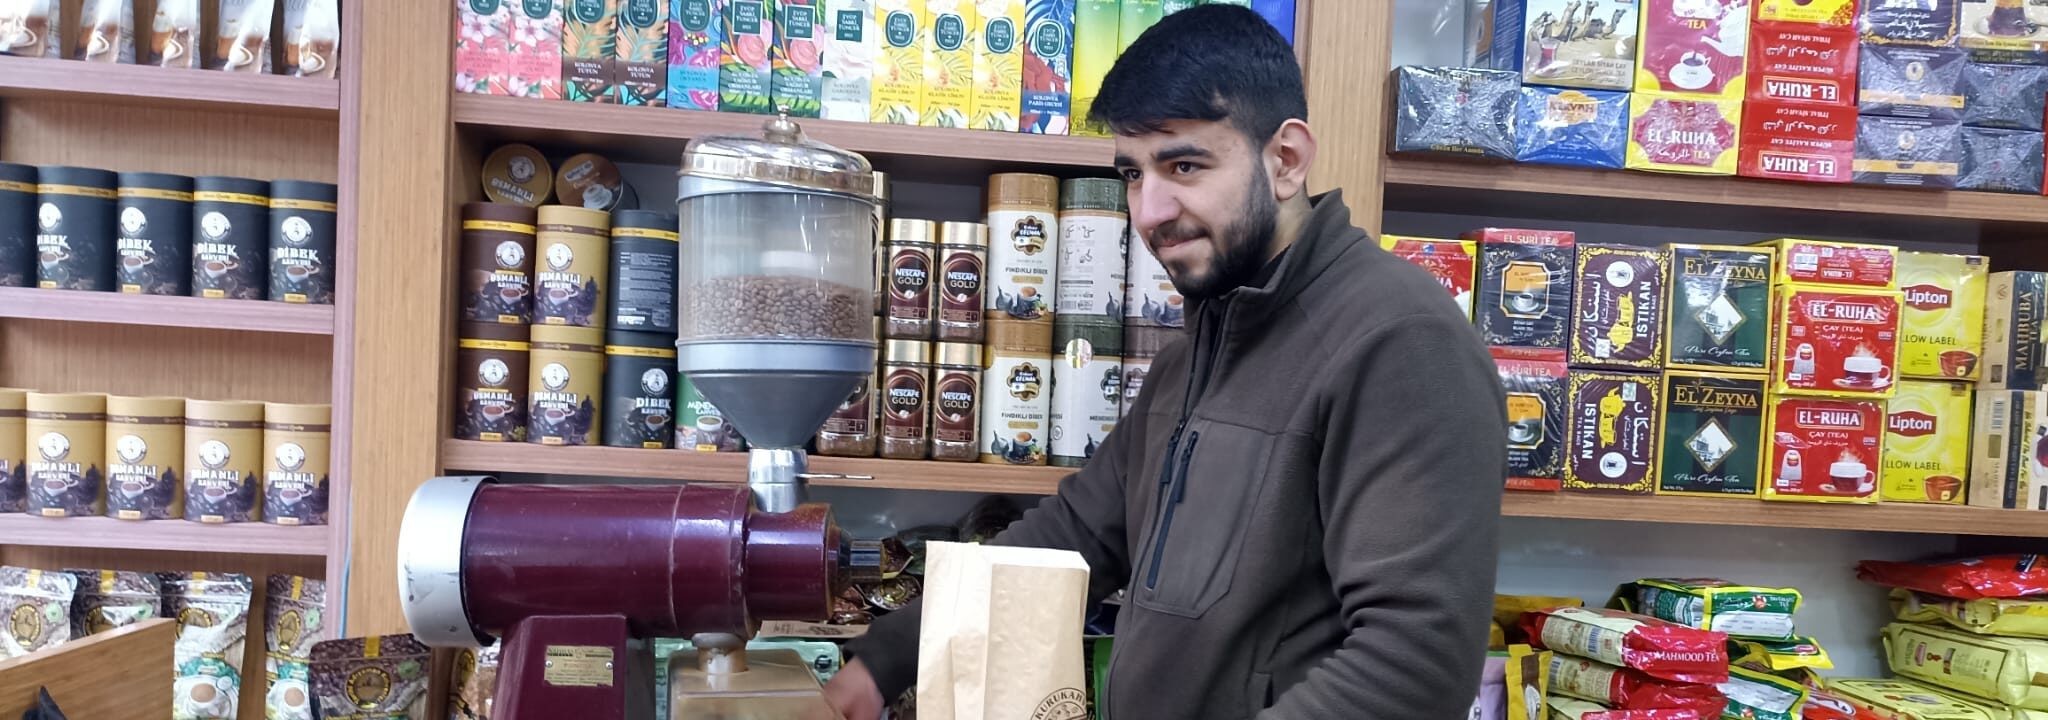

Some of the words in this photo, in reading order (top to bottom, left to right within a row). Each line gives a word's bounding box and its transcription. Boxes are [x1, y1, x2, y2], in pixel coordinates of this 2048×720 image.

[1687, 19, 1708, 30] TEA
[1767, 81, 1837, 99] EL-RUHA
[1763, 156, 1834, 175] EL-RUHA
[1504, 235, 1516, 243] EL
[1517, 235, 1538, 245] SURİ
[1684, 259, 1708, 276] EL
[1711, 260, 1767, 280] ZEYNA
[898, 277, 924, 286] GOLD
[951, 281, 975, 289] GOLD
[1905, 289, 1948, 305] Lipton
[1636, 281, 1651, 338] ISTIKAN
[1812, 303, 1877, 320] EL-RUHA
[1821, 325, 1840, 333] ÇAY
[1842, 326, 1864, 334] (TEA)
[2015, 292, 2033, 370] MAHBUBA
[1904, 334, 1927, 344] LOW
[1929, 336, 1956, 345] LABEL
[1512, 365, 1532, 376] SURİ
[1534, 367, 1551, 376] TEA
[892, 396, 917, 405] GOLD
[1675, 387, 1698, 403] EL
[1701, 387, 1758, 406] ZEYNA
[636, 396, 671, 410] DİBEK
[944, 400, 969, 409] GOLD
[1799, 411, 1860, 426] EL-RUHA
[1890, 416, 1932, 431] Lipton
[1582, 403, 1597, 459] ISTIKAN
[1809, 431, 1825, 440] ÇAY
[1827, 432, 1849, 440] (TEA)
[1886, 460, 1912, 469] LLOW
[1914, 461, 1940, 470] LABEL
[1697, 474, 1723, 484] Ceylon
[1653, 651, 1704, 661] MAHMOOD
